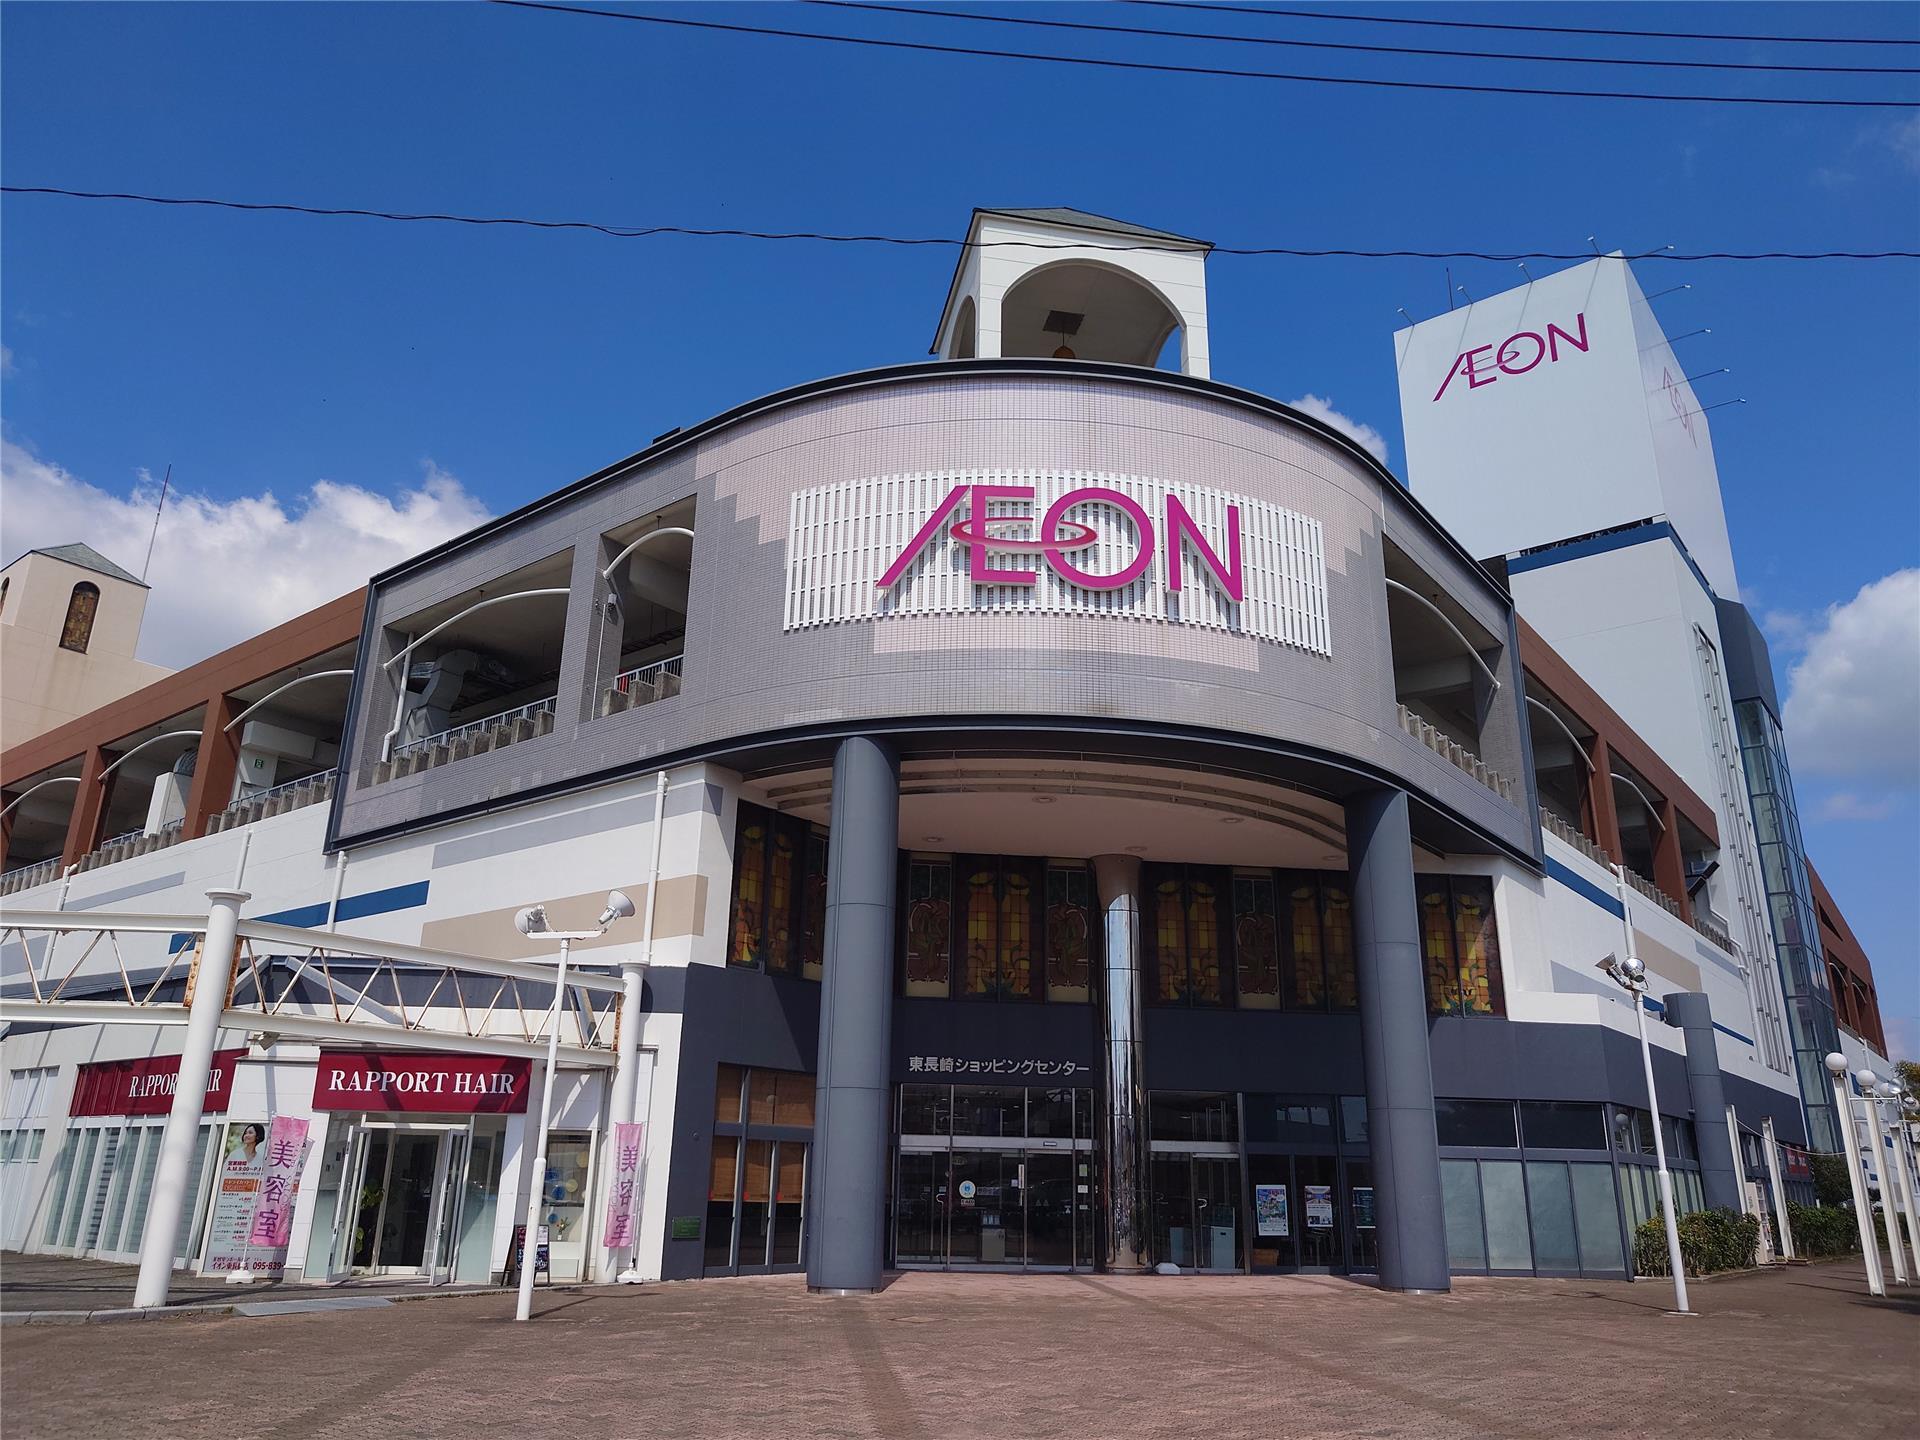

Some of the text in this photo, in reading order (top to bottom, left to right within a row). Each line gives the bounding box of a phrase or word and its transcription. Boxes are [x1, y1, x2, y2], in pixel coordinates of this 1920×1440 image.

[908, 1056, 1090, 1076] 東長崎ショッピングセンター
[128, 1072, 180, 1098] RAPPOR
[328, 1070, 515, 1094] RAPPORT HAIR
[254, 1139, 294, 1239] 美容室
